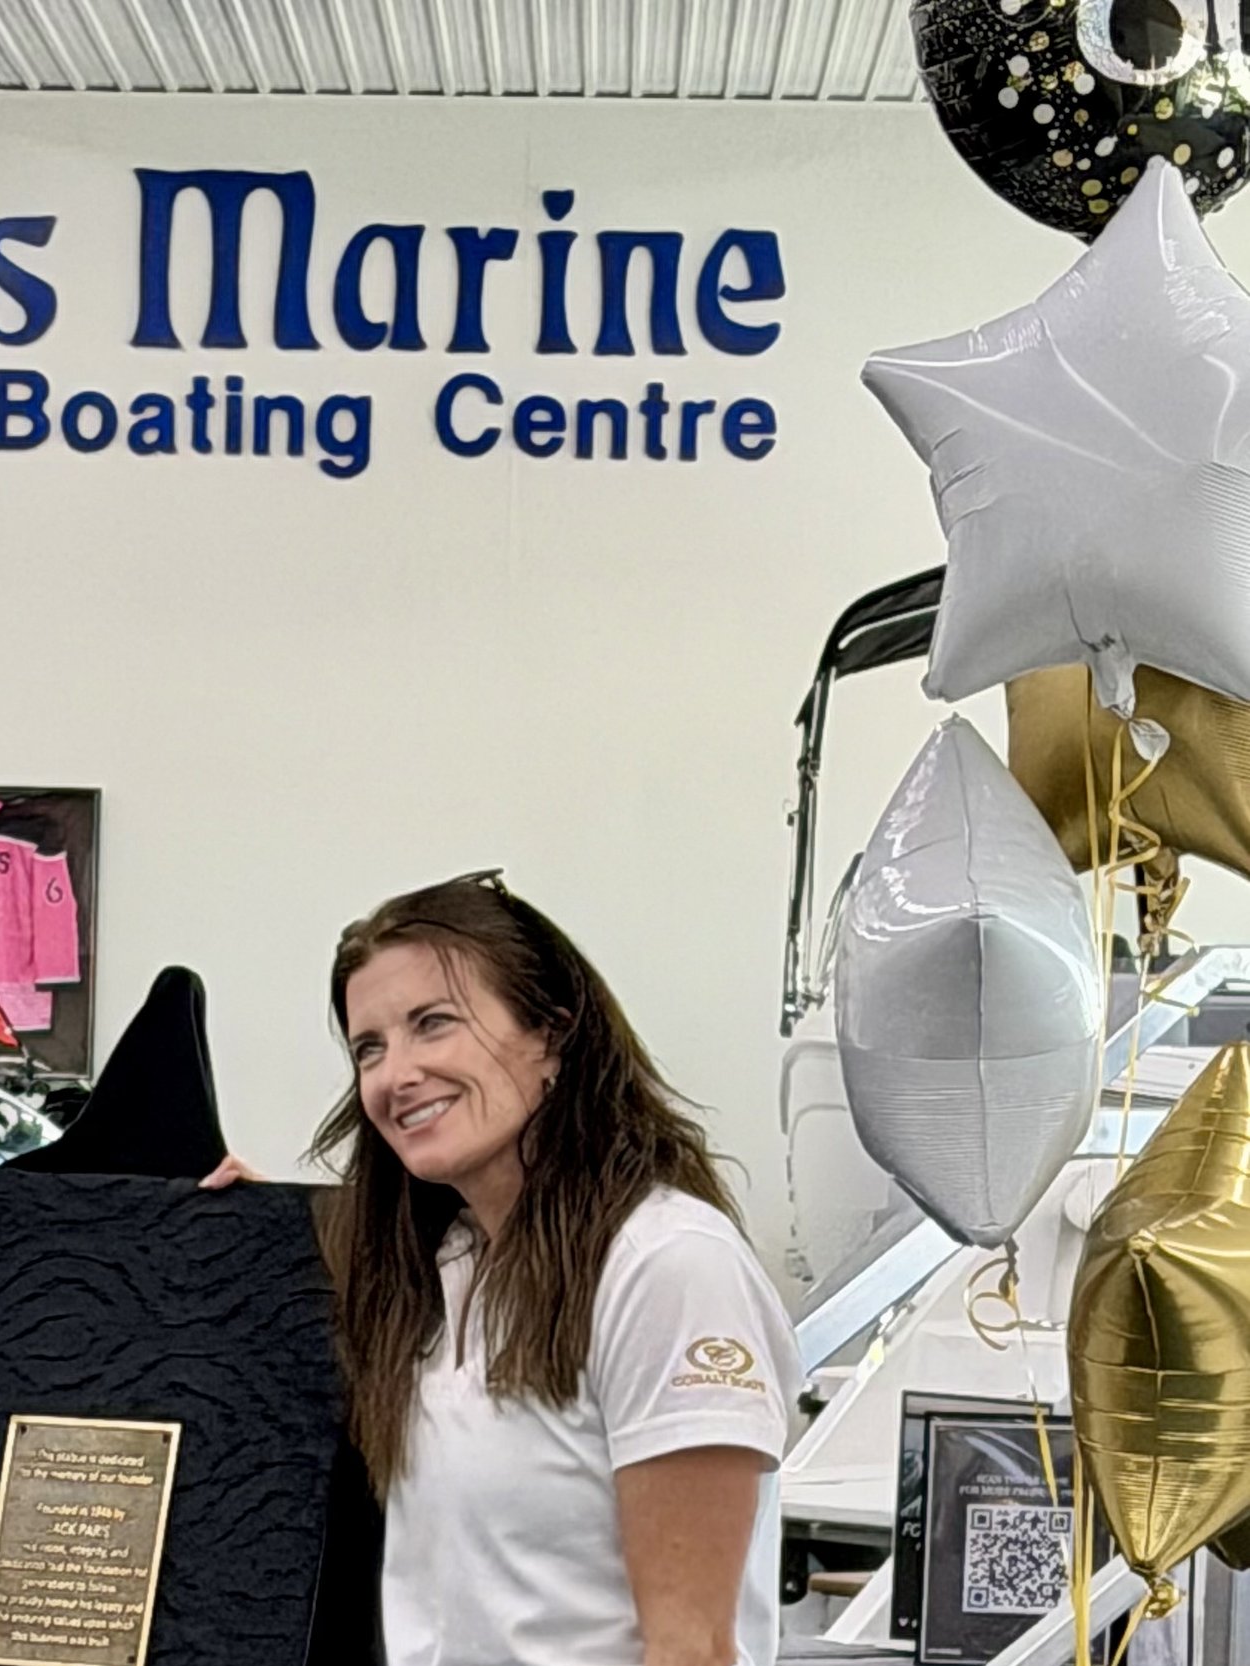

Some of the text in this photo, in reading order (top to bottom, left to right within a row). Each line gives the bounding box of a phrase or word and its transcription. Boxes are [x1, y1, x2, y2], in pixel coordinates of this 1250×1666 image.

[130, 168, 786, 356] Marine
[435, 373, 777, 461] Centre
[46, 877, 63, 905] 6
